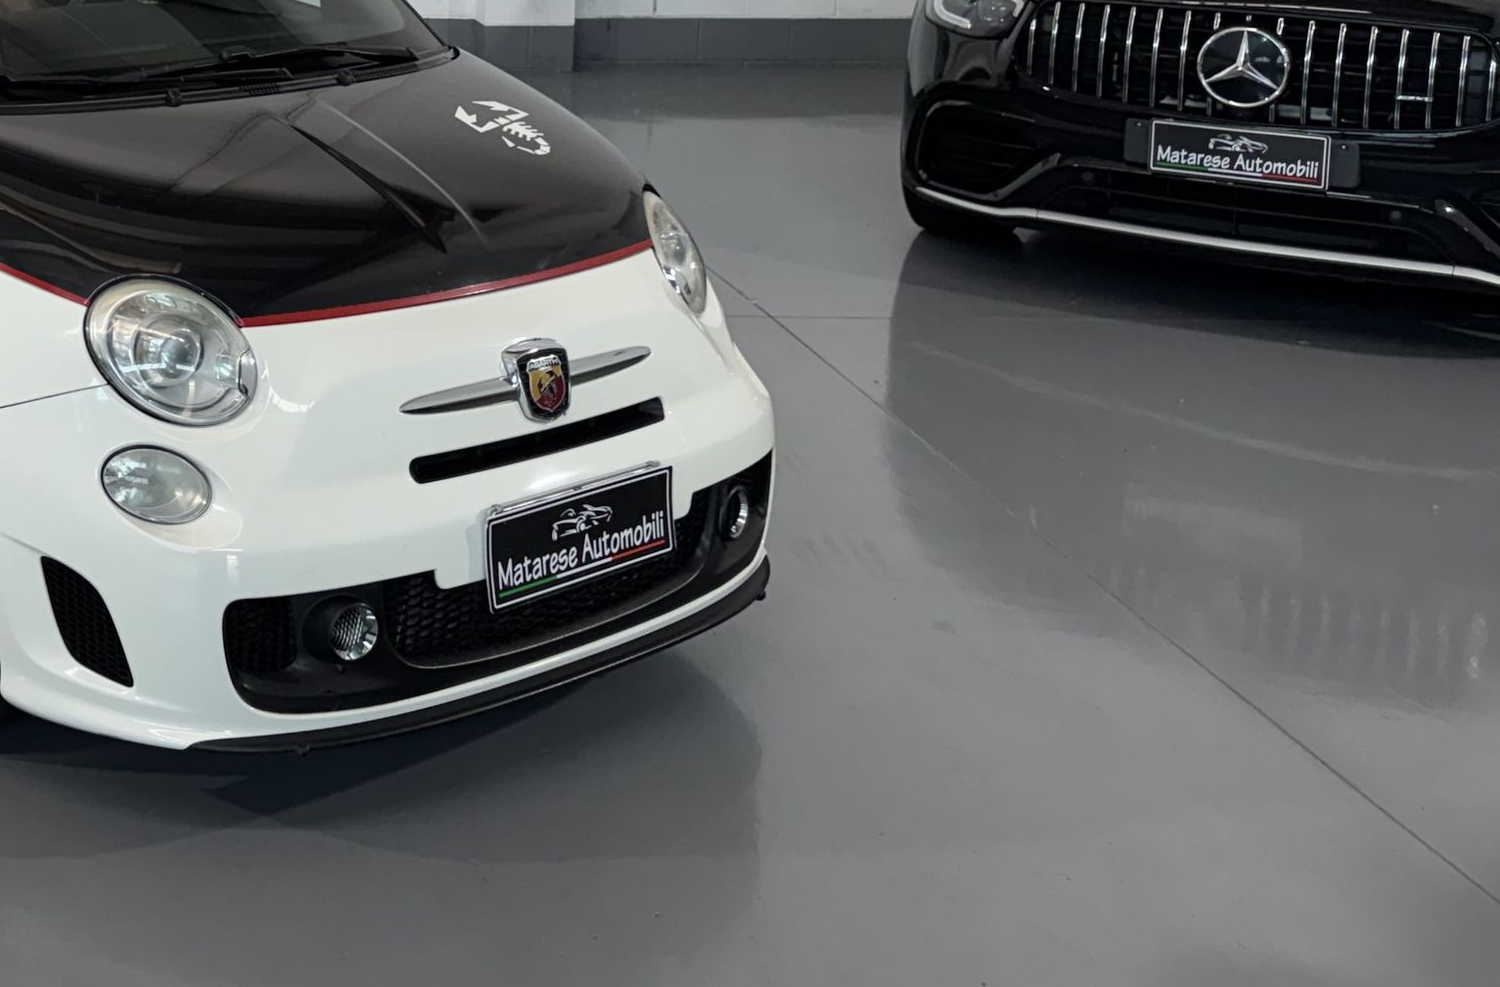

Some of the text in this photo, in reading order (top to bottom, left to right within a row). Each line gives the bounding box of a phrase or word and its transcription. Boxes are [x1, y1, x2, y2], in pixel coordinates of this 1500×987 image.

[1156, 144, 1319, 179] Matarese Automobili
[498, 510, 665, 591] Matarese Automobili
